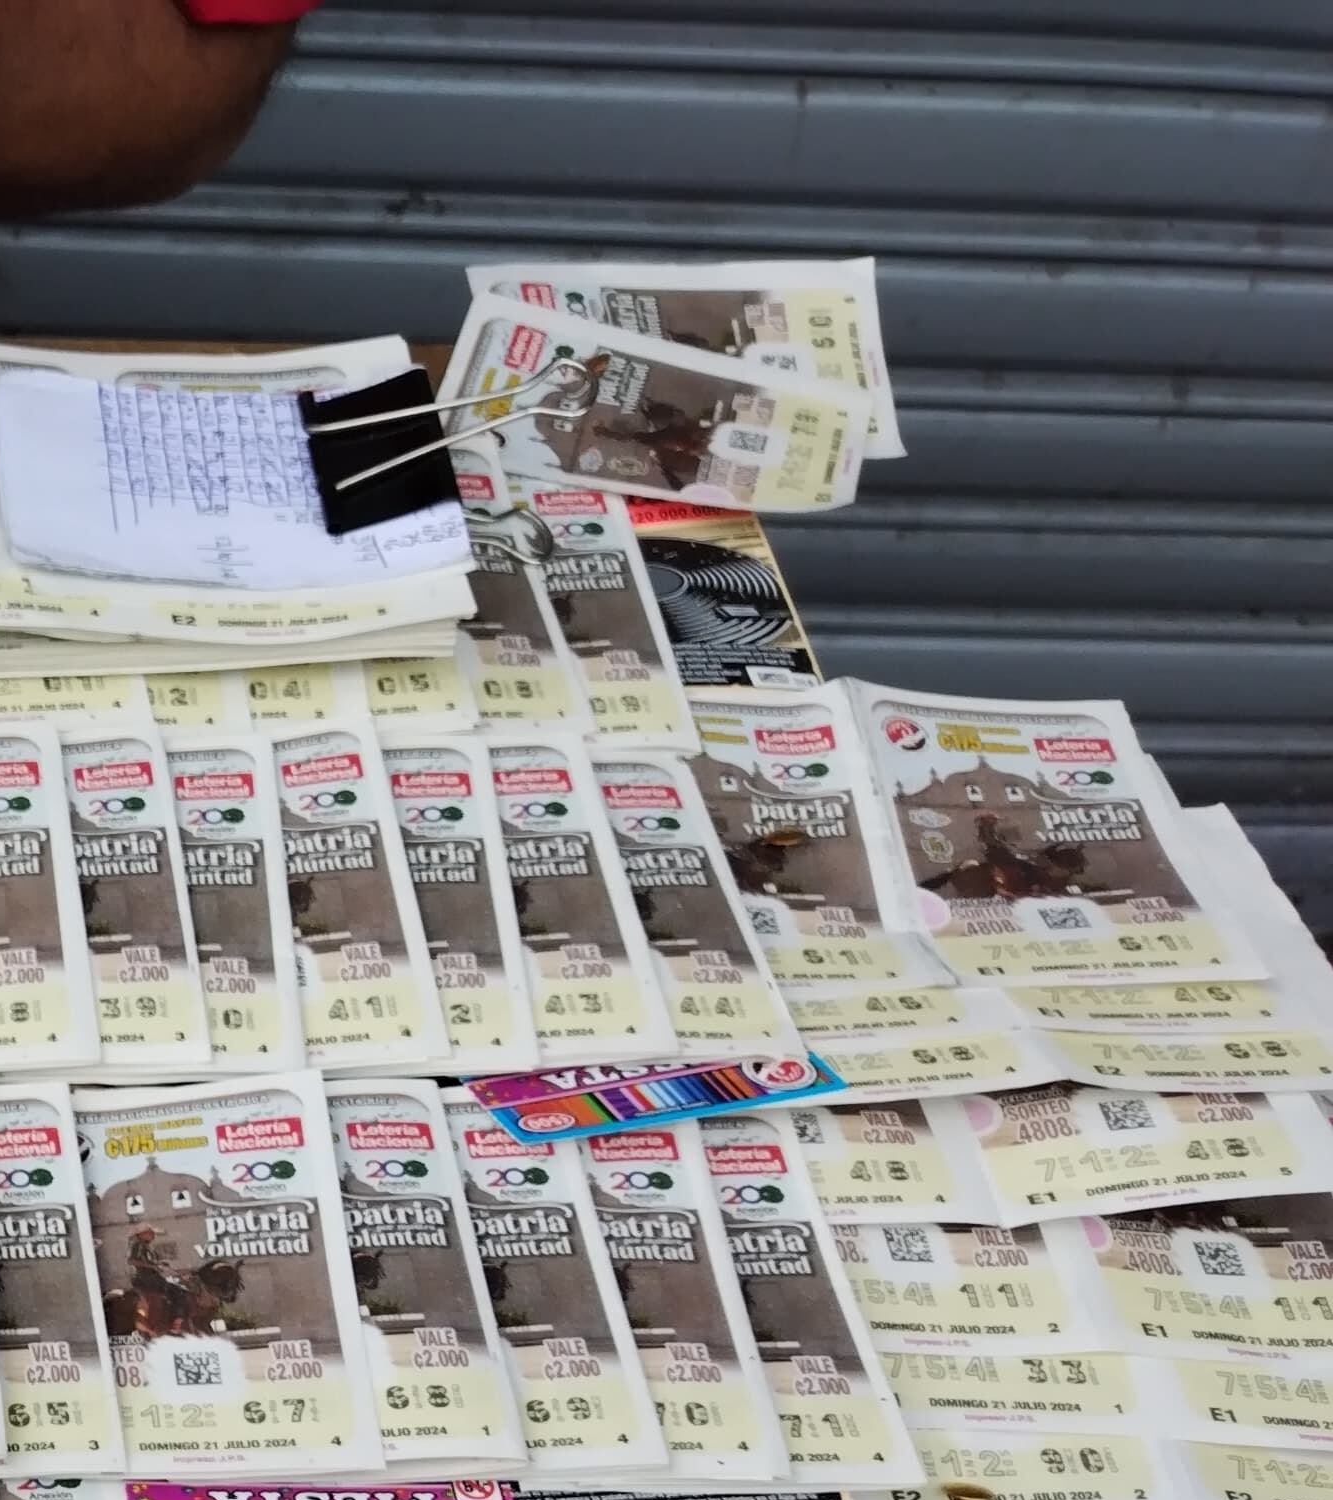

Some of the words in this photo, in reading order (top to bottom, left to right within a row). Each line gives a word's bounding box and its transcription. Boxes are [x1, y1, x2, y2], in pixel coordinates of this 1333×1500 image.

[206, 1204, 309, 1237] patria
[195, 1232, 310, 1256] voluntad
[272, 1343, 309, 1362] VALE
[139, 1440, 200, 1451] DOMINGO
[203, 1440, 219, 1450] 21
[222, 1439, 261, 1450] JULIO
[264, 1437, 296, 1448] 2024
